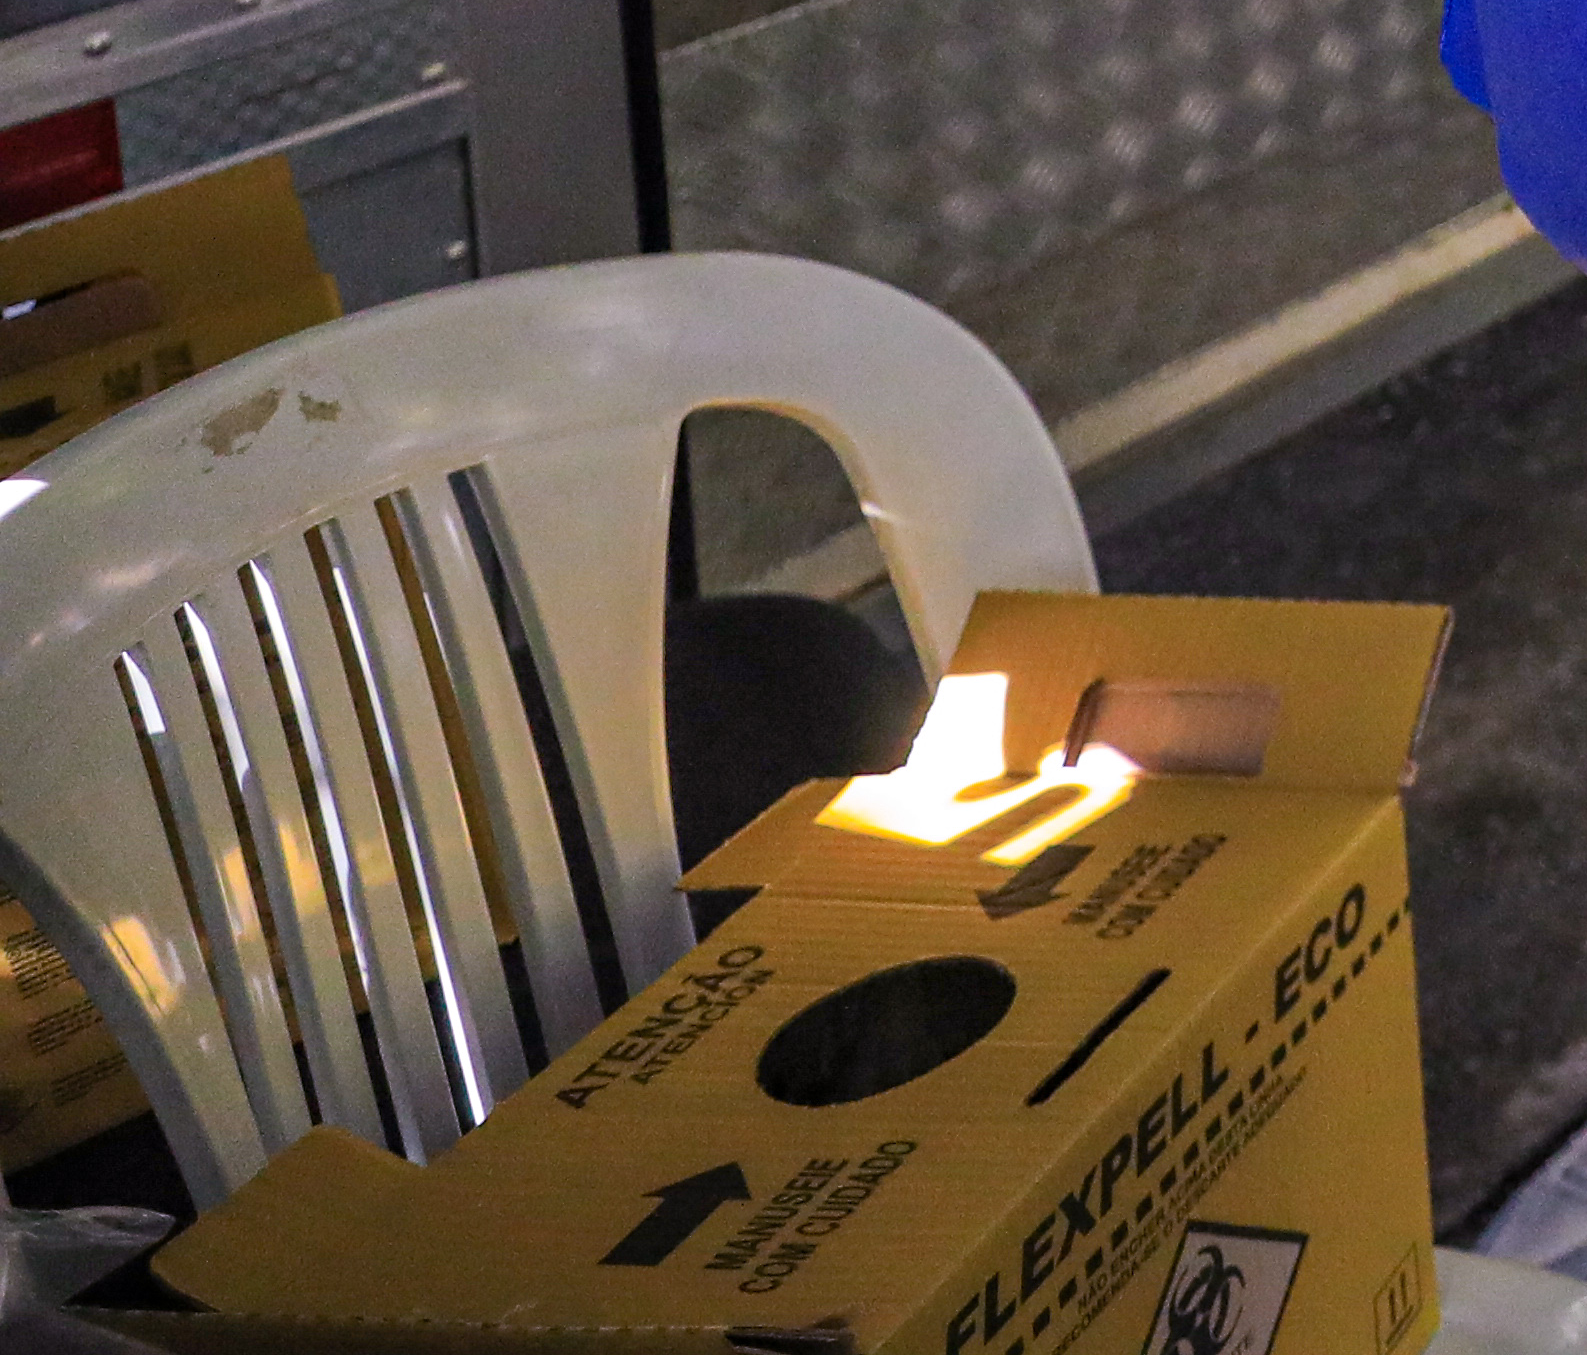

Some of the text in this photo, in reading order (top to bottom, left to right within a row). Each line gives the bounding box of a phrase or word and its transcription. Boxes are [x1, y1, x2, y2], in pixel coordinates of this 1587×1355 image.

[555, 945, 764, 1109] ATENÇÃO
[946, 1042, 1229, 1355] FLEXPELL
[1274, 883, 1366, 1023] ECO
[704, 1158, 849, 1271] MANUSEIE
[738, 1140, 918, 1294] COM CUIDADO
